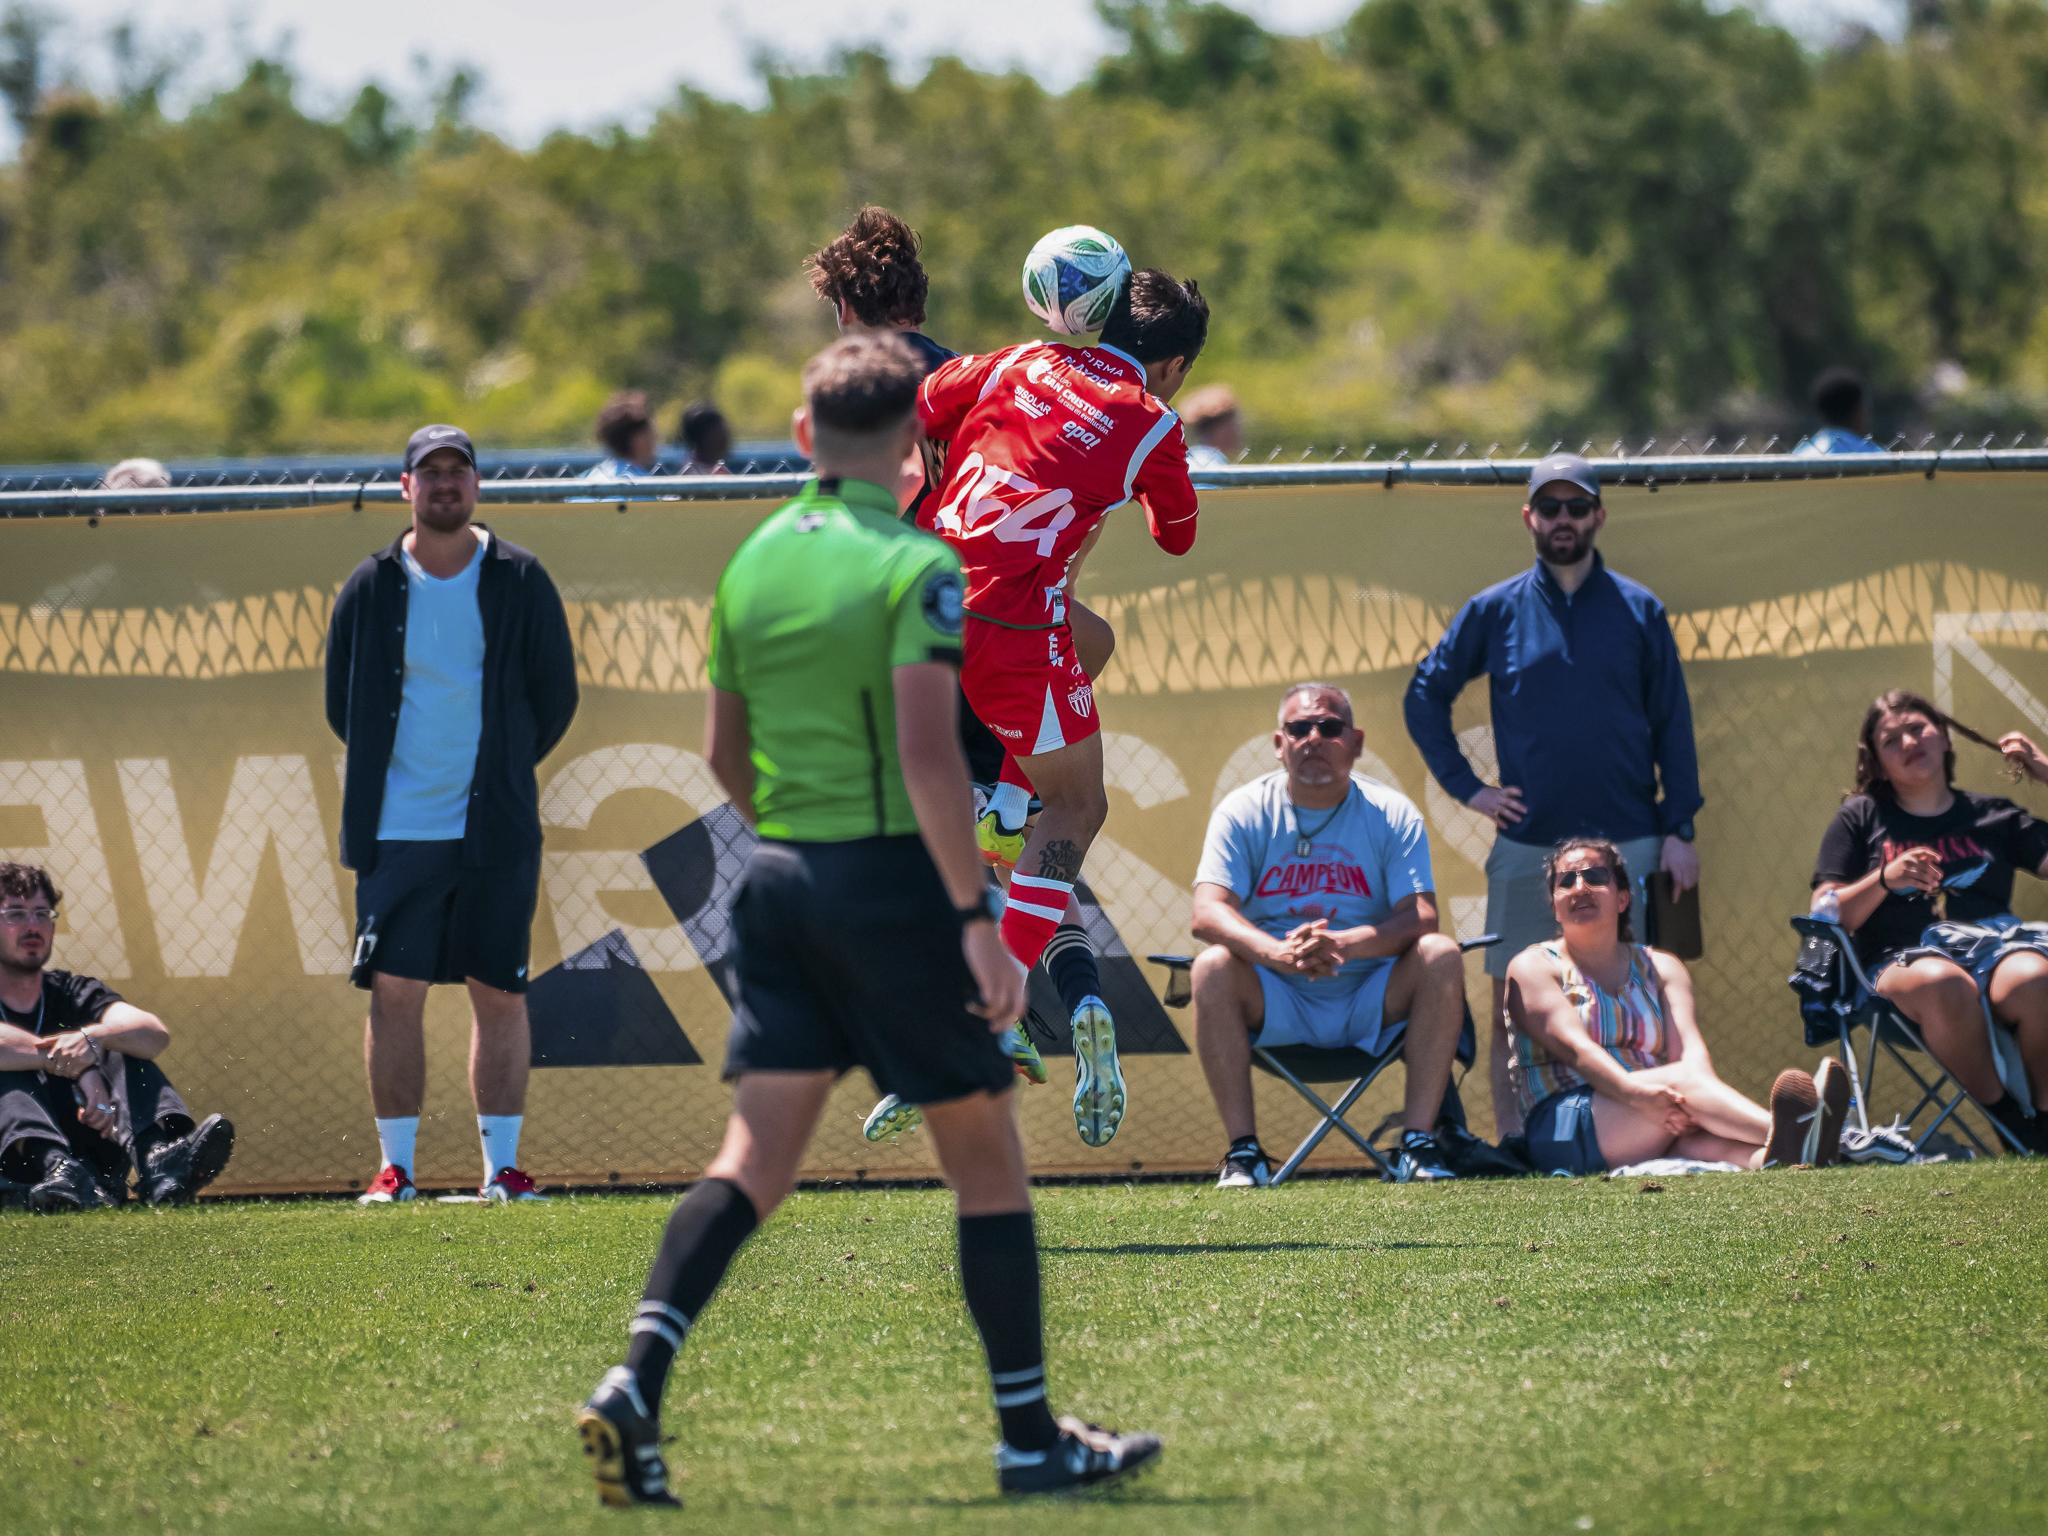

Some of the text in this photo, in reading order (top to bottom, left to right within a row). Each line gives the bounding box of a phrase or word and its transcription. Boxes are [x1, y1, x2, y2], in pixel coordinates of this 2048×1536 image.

[1081, 350, 1124, 376] PIRMA
[1041, 375, 1064, 393] SAN
[1014, 385, 1052, 415] SISOLAR
[1063, 401, 1075, 412] casa
[1073, 407, 1082, 416] en
[1062, 420, 1101, 451] epa!
[1255, 861, 1375, 900] CAMPEÓN
